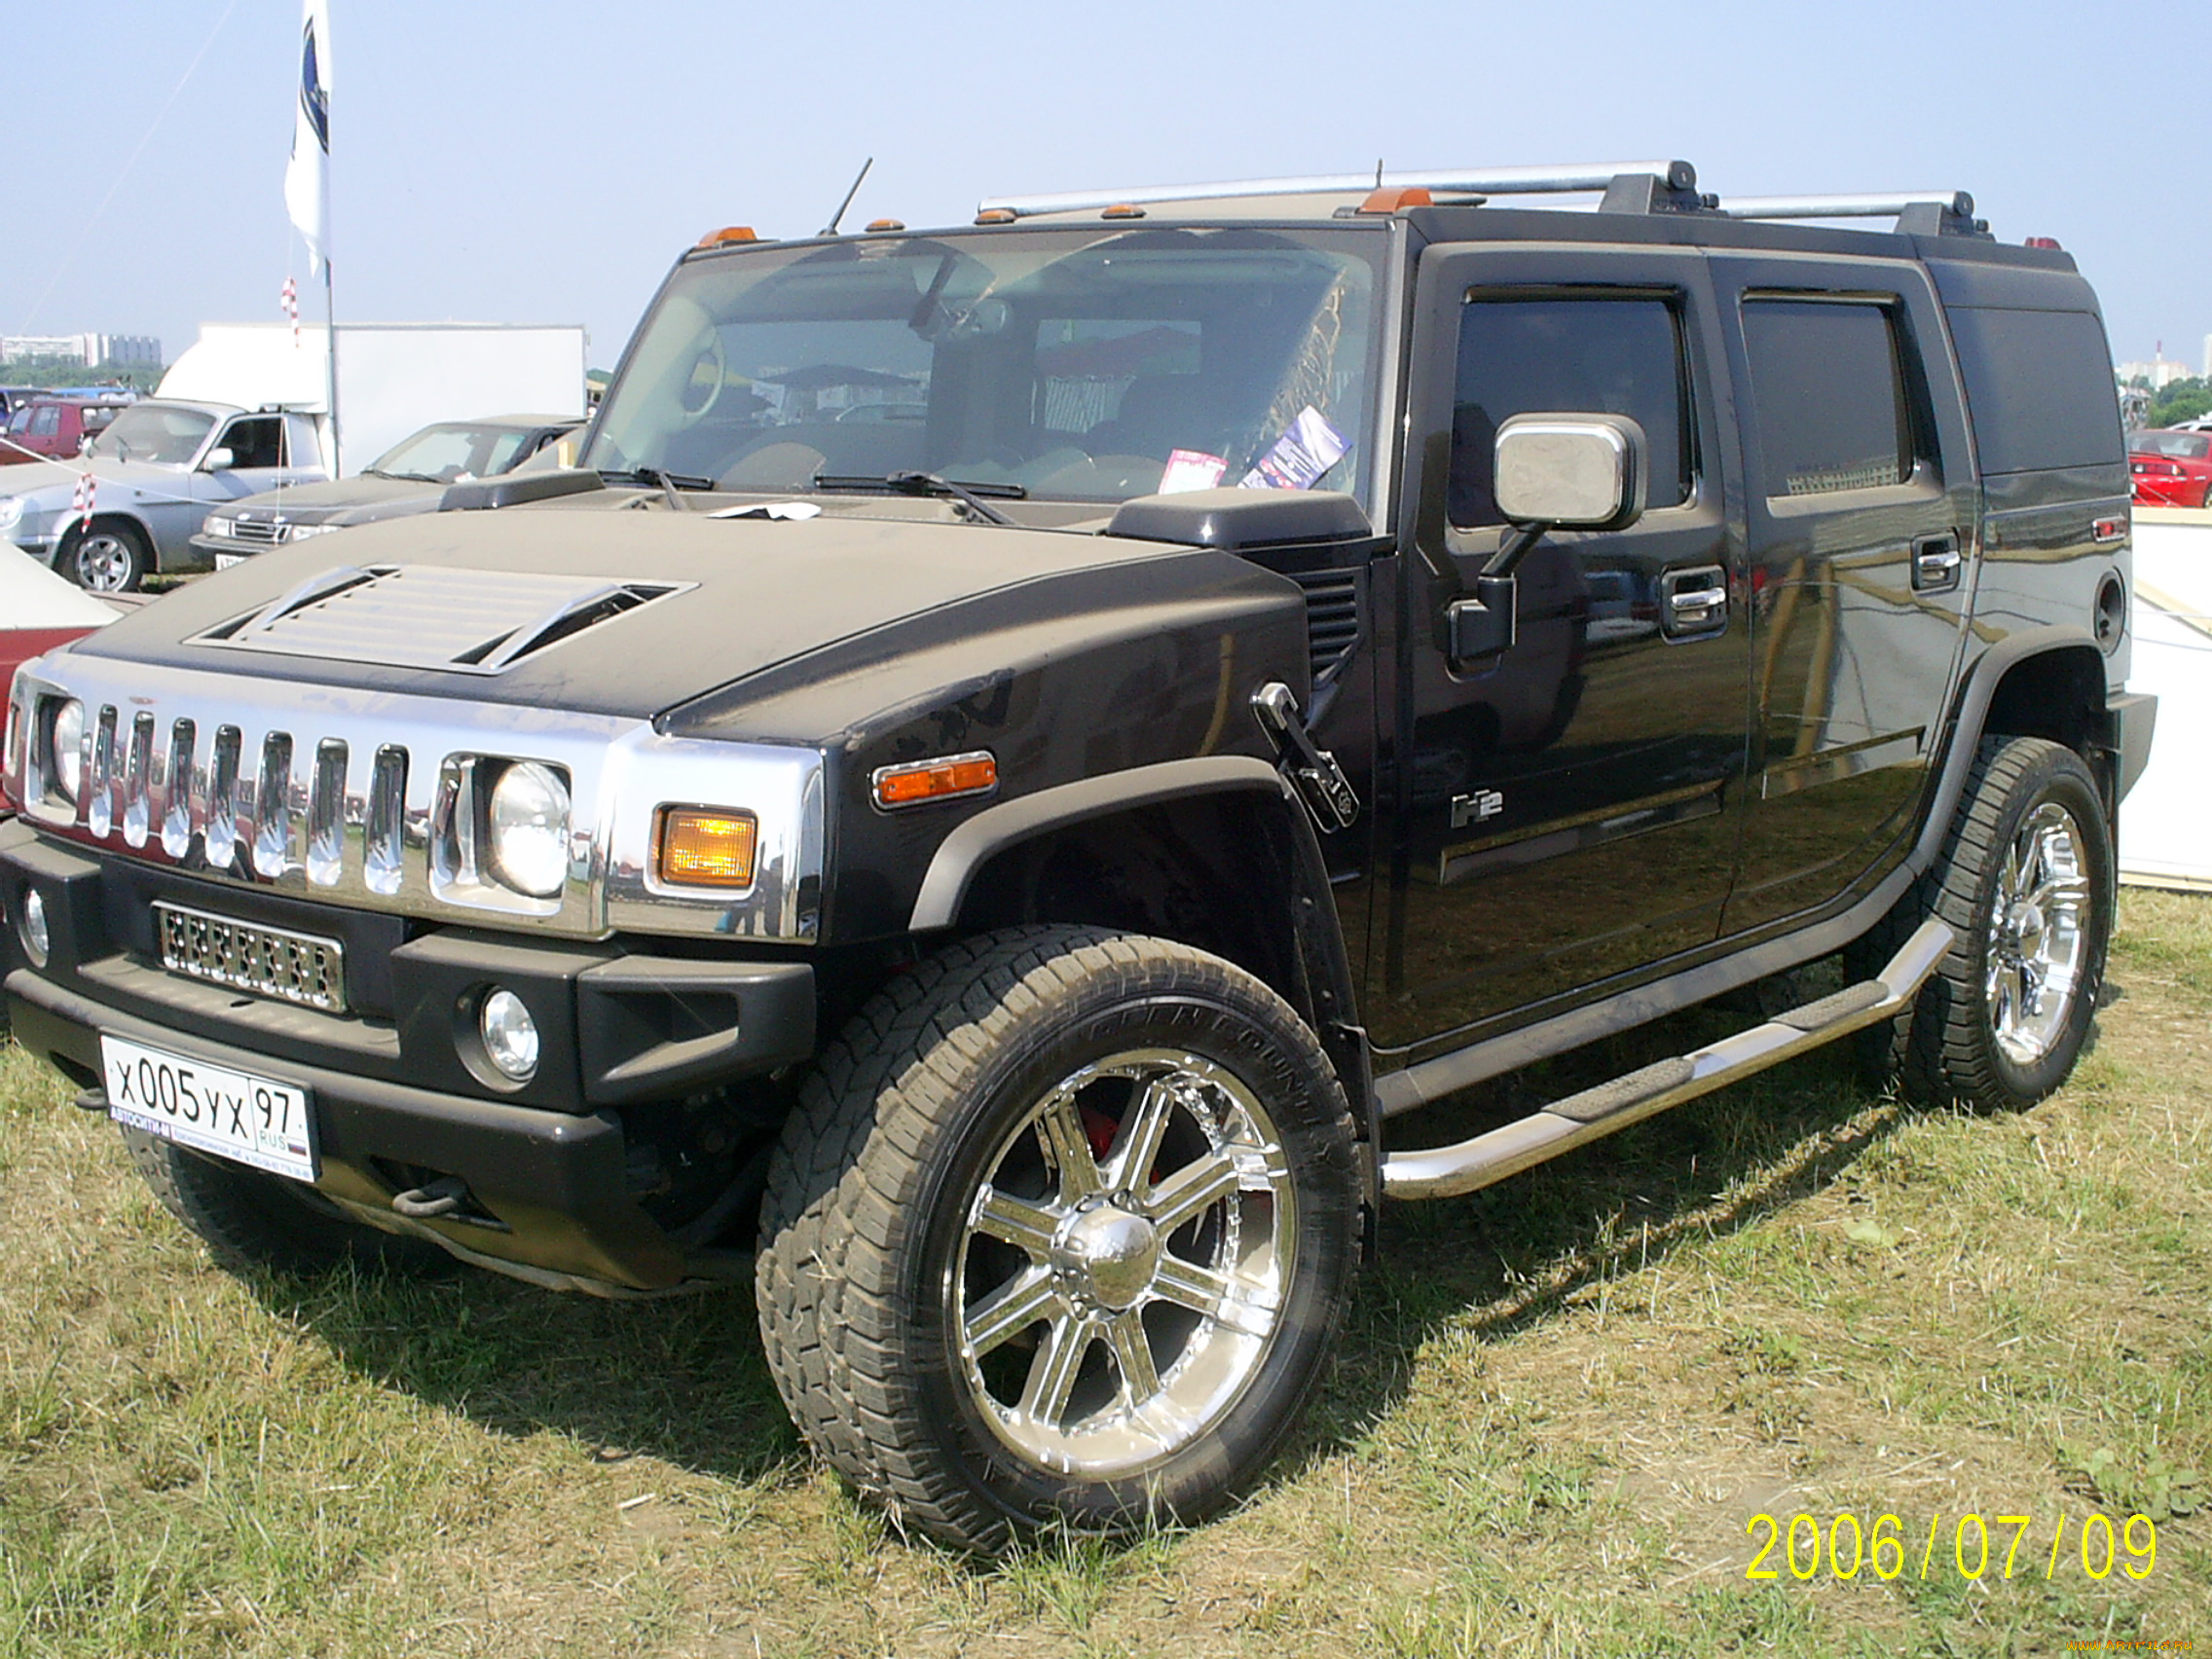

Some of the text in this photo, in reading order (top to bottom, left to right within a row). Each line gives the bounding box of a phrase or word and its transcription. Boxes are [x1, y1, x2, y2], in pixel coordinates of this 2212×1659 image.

[1451, 789, 1503, 828] H2
[255, 1088, 289, 1133] 97
[259, 1128, 285, 1151] RUS
